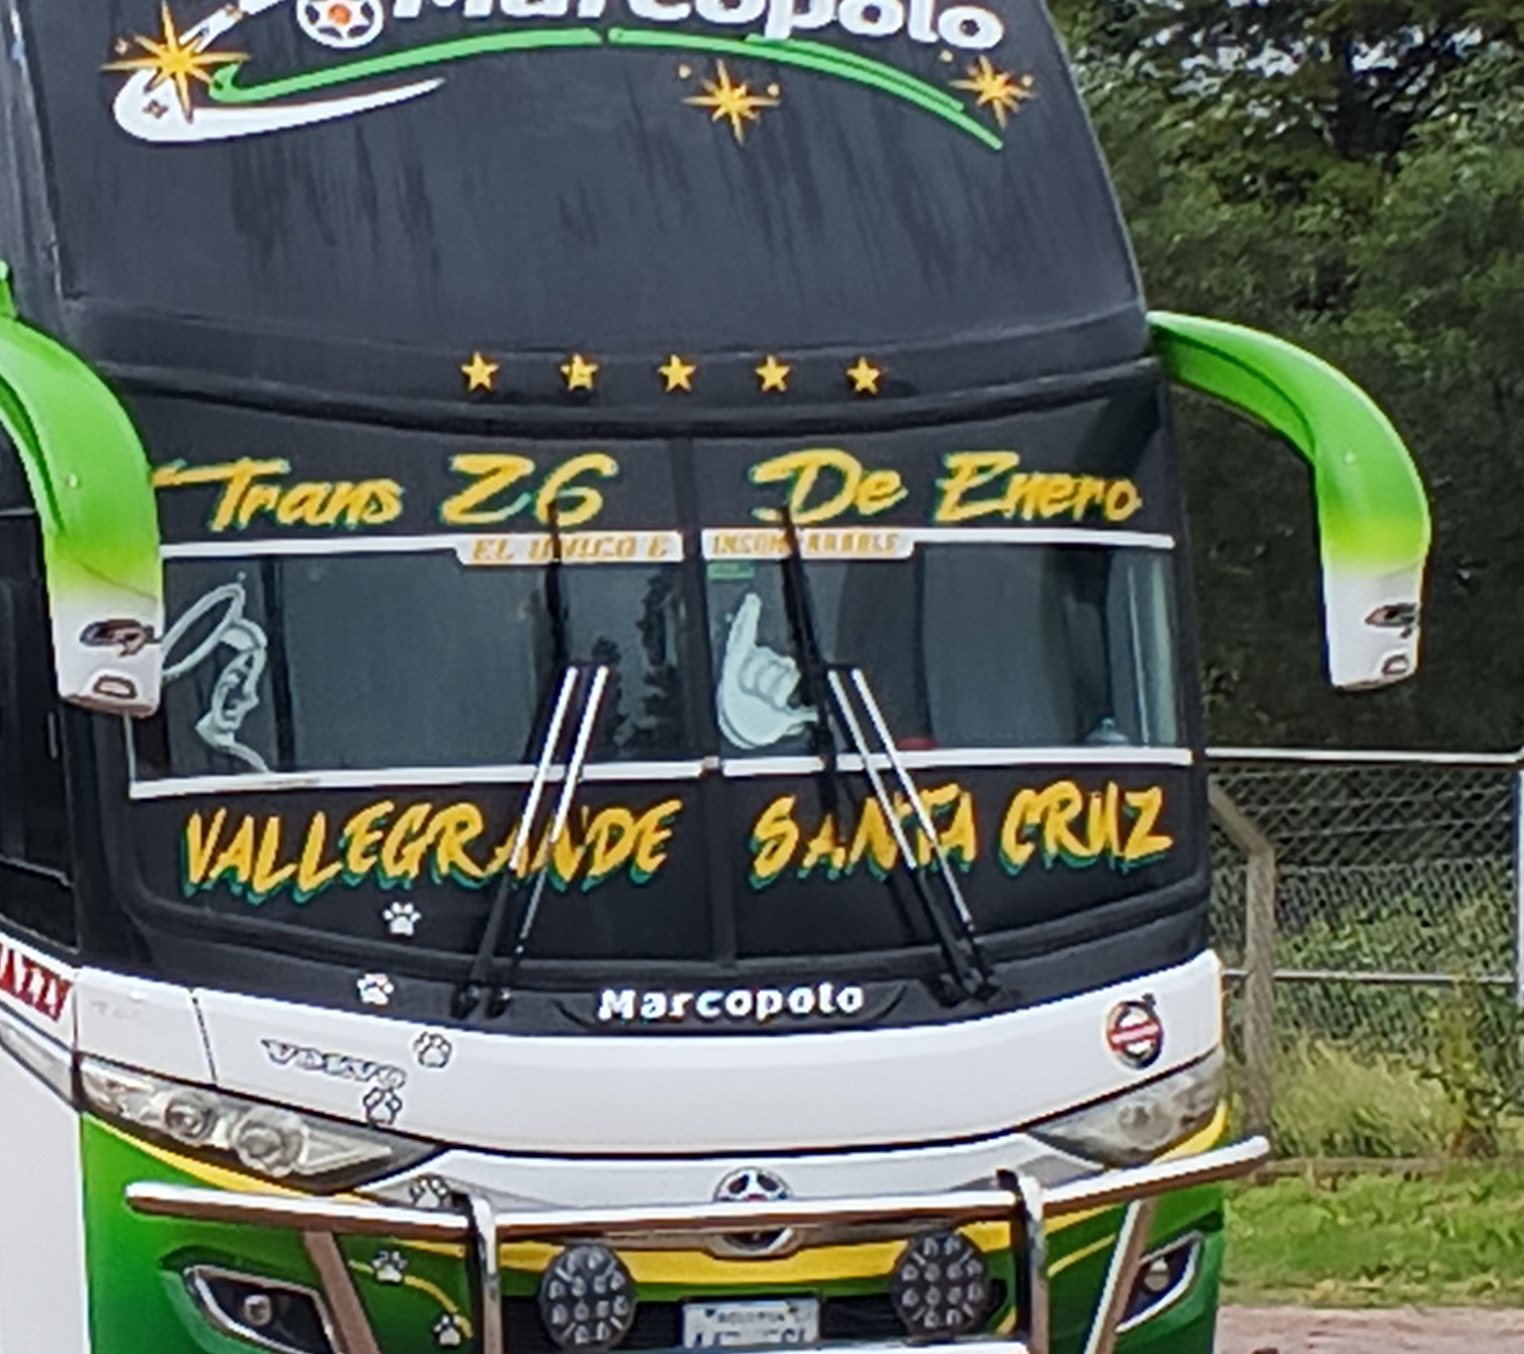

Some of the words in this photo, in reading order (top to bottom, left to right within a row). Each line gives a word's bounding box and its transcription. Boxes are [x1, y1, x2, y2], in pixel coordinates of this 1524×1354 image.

[152, 457, 402, 532] Trans
[750, 448, 907, 524] De
[934, 450, 1143, 523] Enero
[185, 799, 682, 901] VALLEGRANDE
[1000, 779, 1174, 874] CRUZ
[597, 982, 865, 1022] Marcopolo
